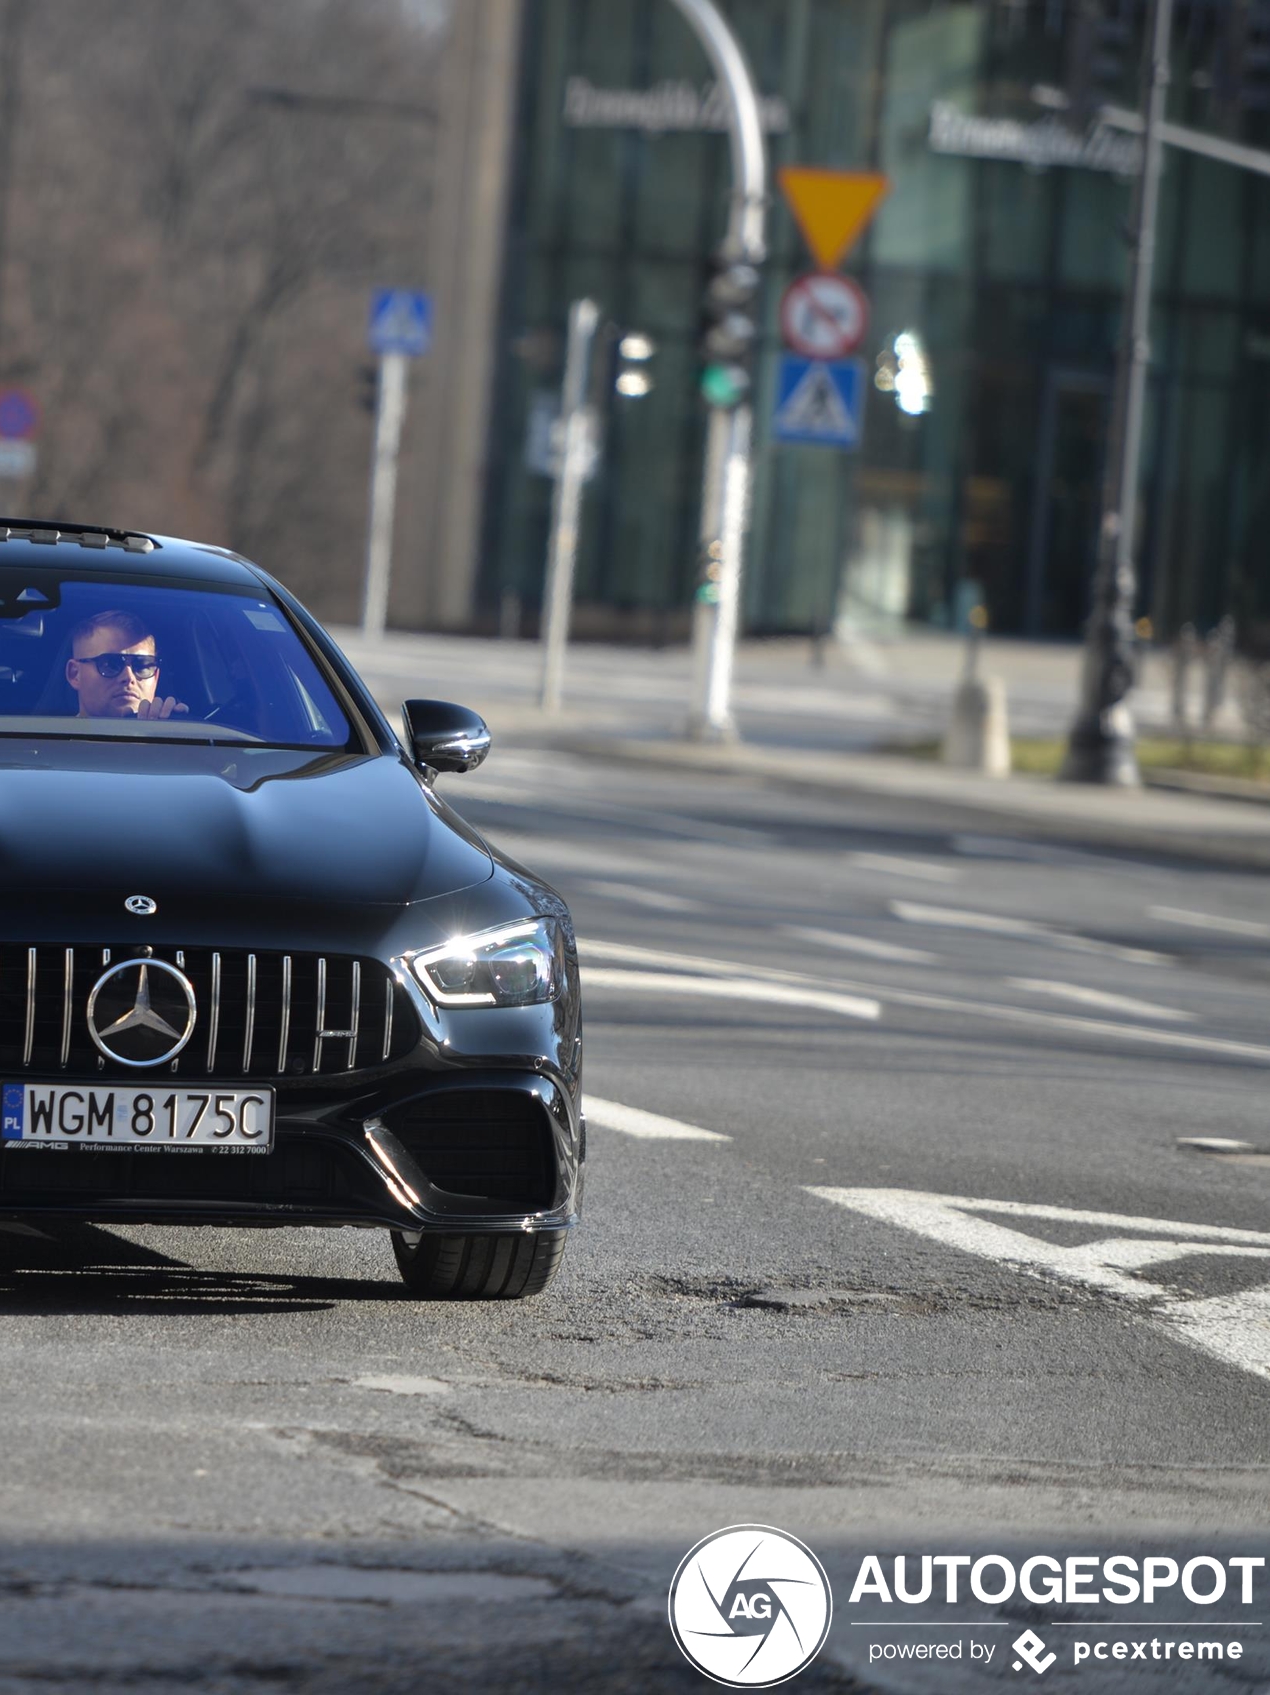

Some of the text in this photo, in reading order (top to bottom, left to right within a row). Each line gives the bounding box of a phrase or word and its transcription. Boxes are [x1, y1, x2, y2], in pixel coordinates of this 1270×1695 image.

[30, 1090, 265, 1139] WGM 8175C
[4, 1117, 20, 1129] PL
[25, 1141, 267, 1154] AMG Performance Center Warszawa 22 312 7000
